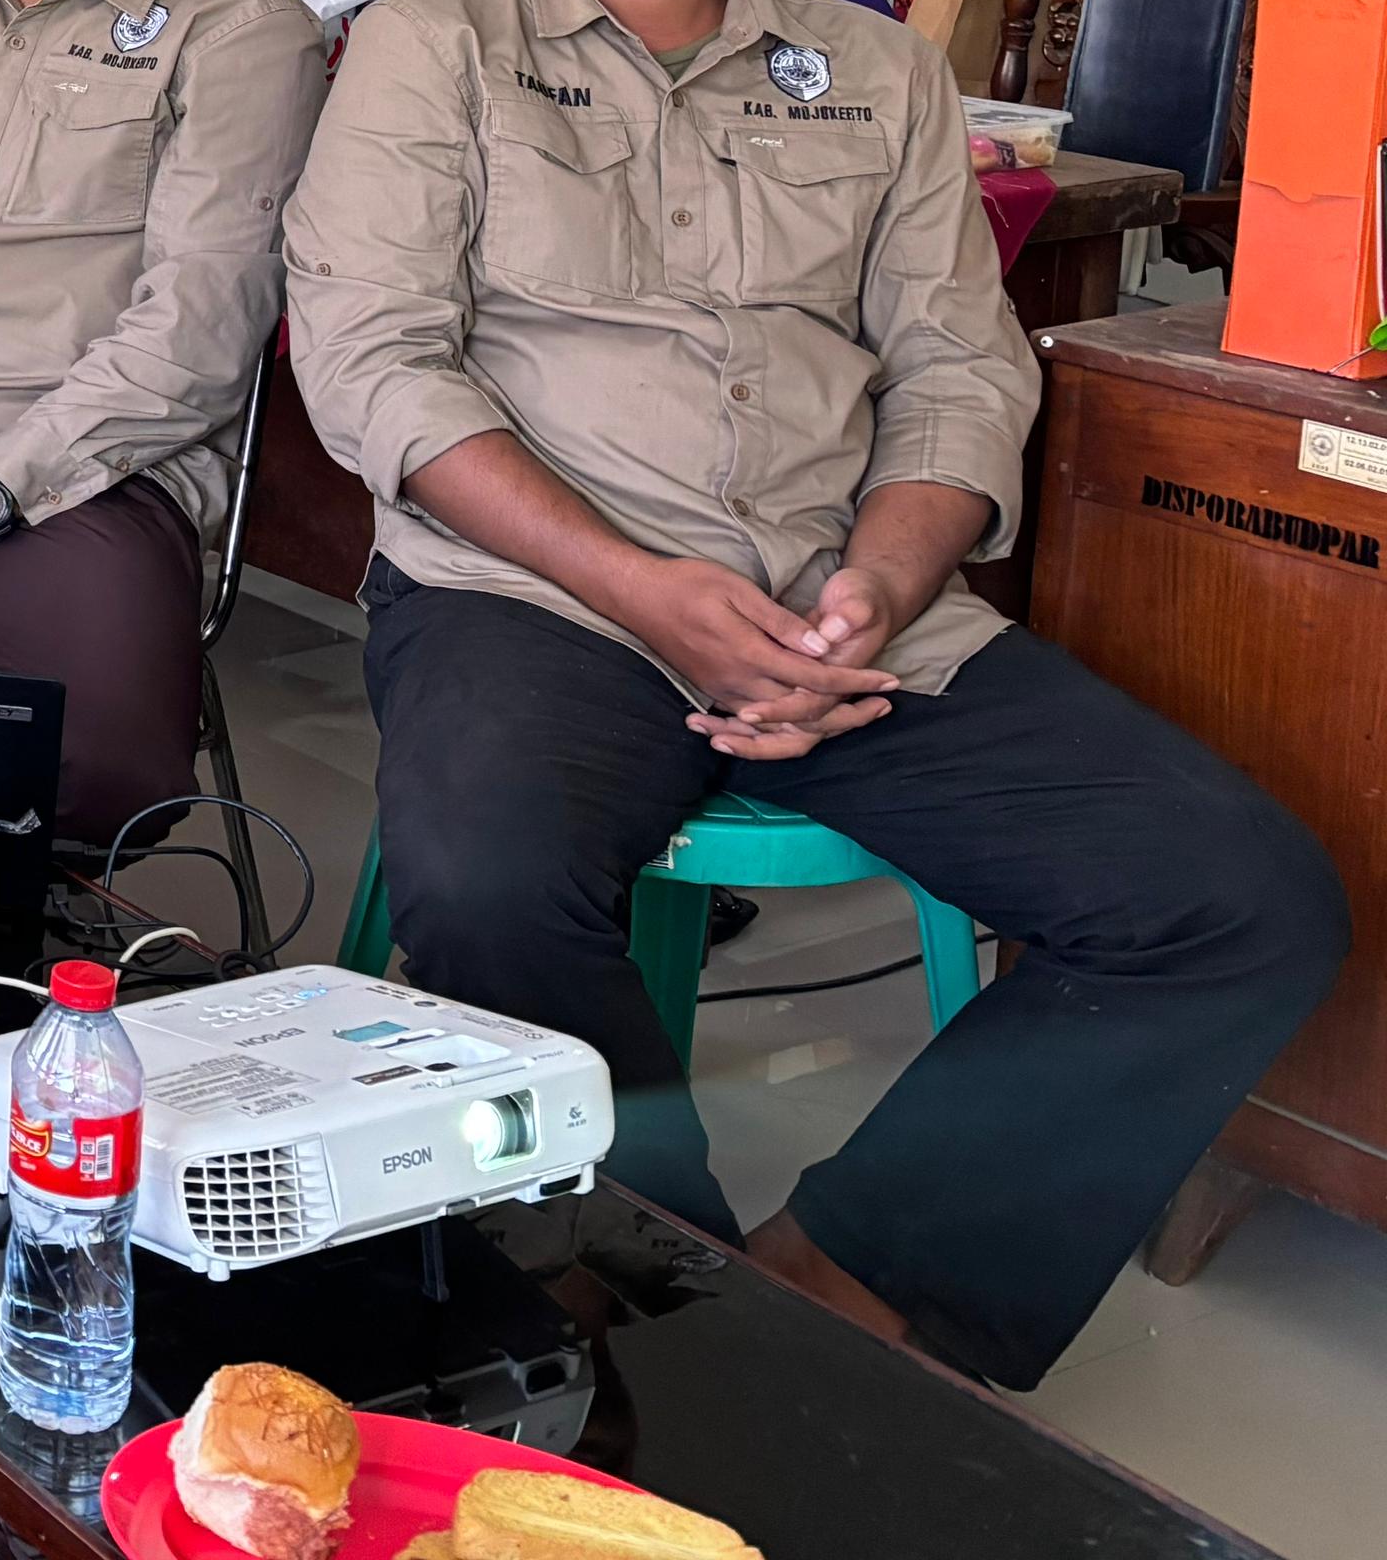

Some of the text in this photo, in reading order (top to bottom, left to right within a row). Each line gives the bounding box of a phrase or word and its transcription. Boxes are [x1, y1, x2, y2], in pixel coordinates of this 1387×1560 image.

[67, 44, 159, 71] KAB. MOJOKERTO
[514, 70, 592, 107] TAUFAN
[743, 100, 873, 122] KAB. MOJOKERTO
[1141, 474, 1380, 570] DISPORABUDPAR
[235, 1027, 307, 1049] EPSON
[382, 1146, 433, 1175] EPSON
